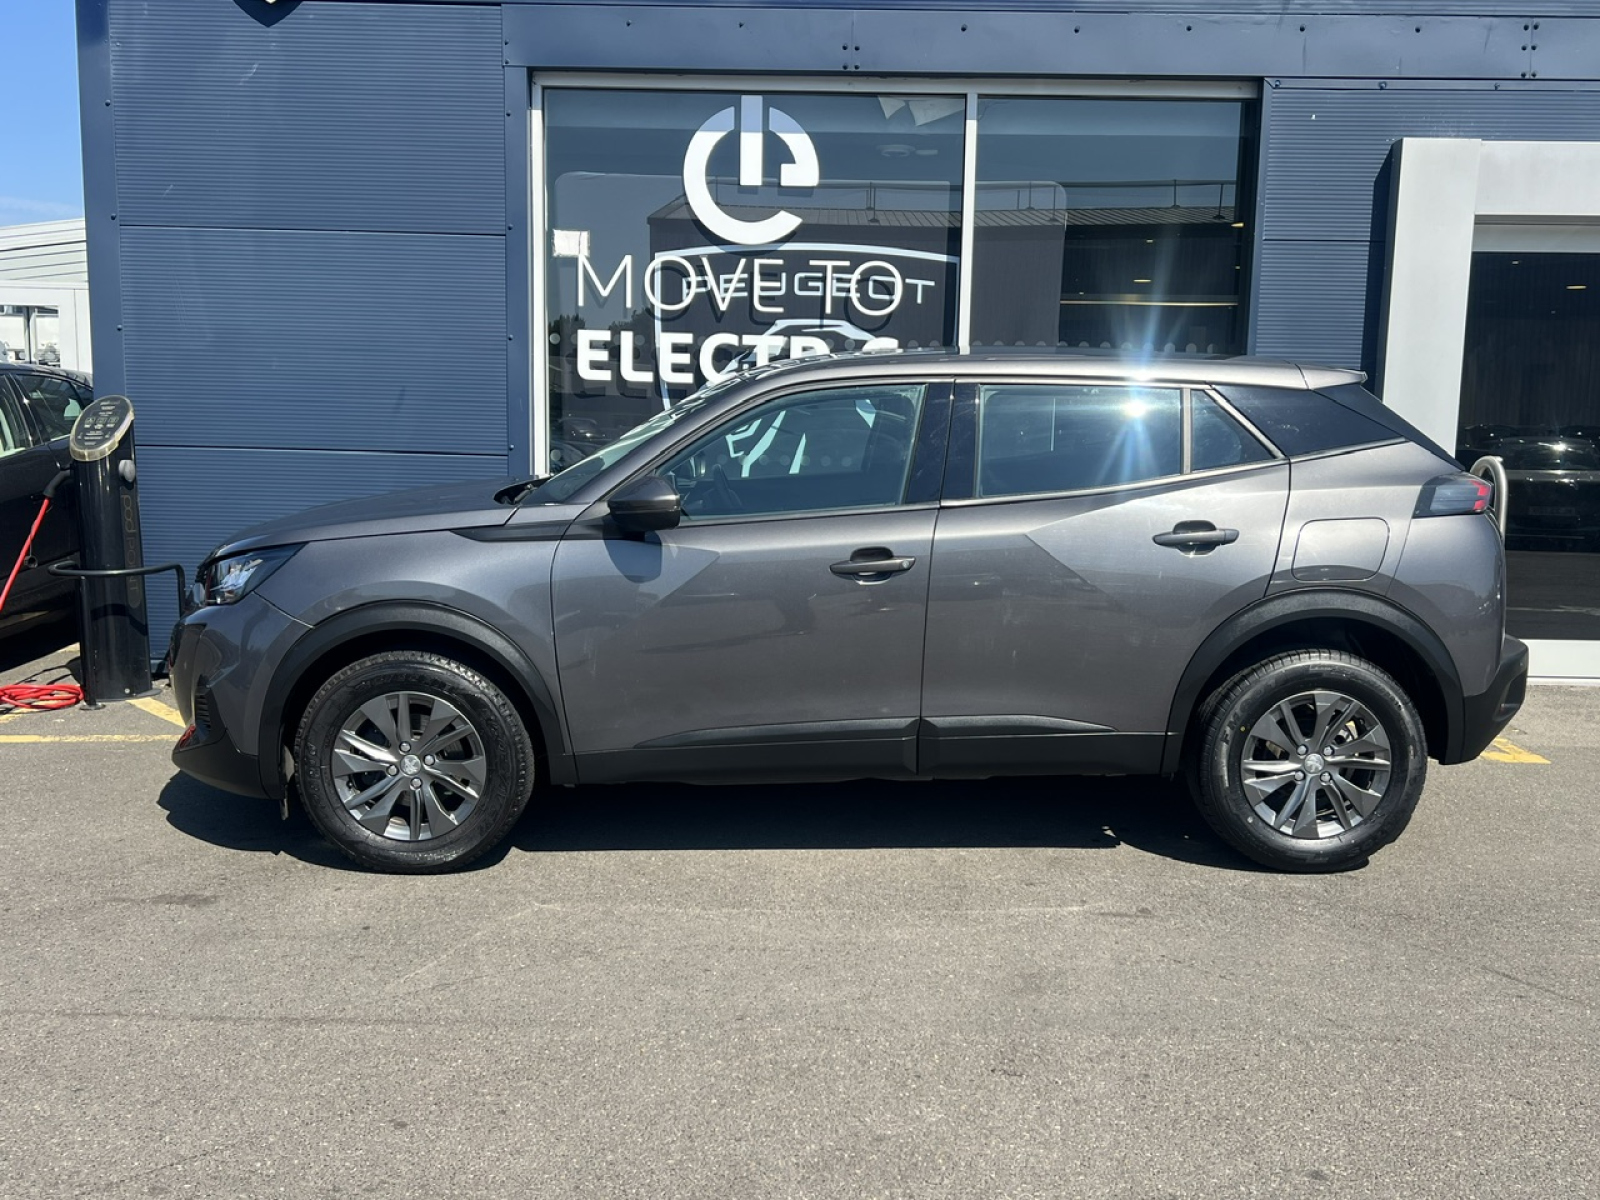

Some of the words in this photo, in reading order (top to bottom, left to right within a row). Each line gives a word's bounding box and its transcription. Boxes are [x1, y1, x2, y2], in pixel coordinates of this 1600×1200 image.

[577, 254, 785, 313] MOVE
[808, 259, 903, 317] TO
[681, 271, 936, 305] PEUGEOT
[576, 328, 900, 385] ELECT
